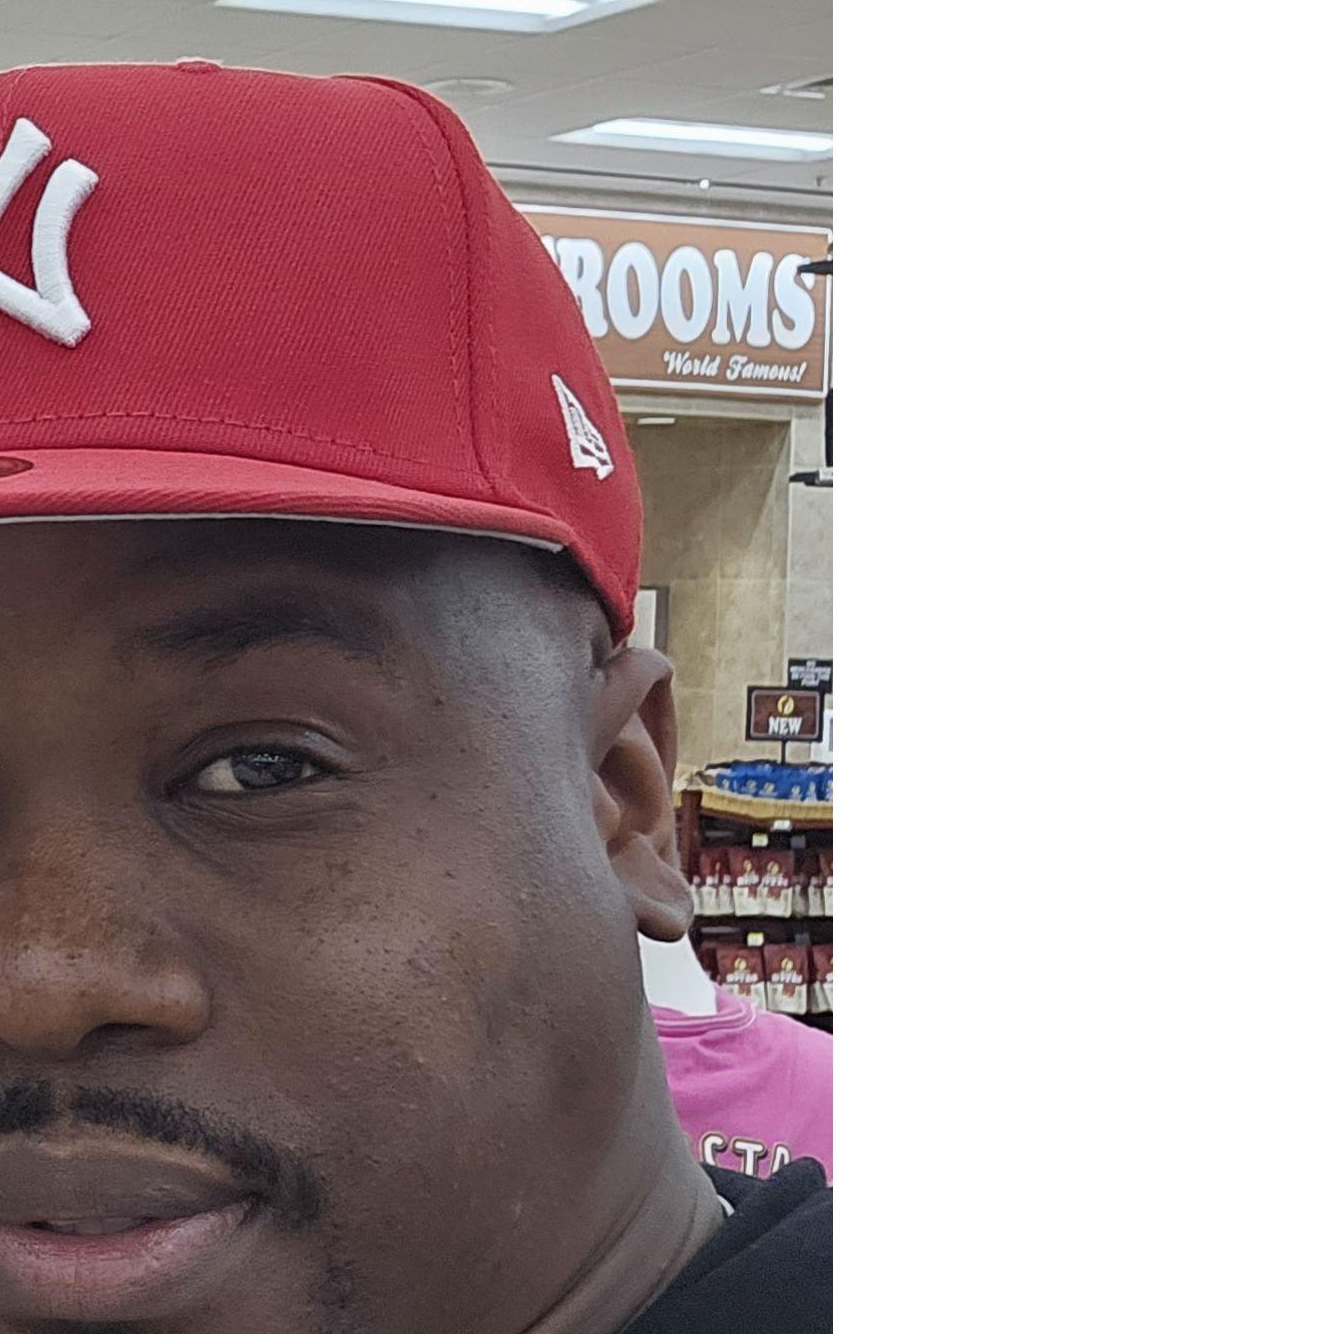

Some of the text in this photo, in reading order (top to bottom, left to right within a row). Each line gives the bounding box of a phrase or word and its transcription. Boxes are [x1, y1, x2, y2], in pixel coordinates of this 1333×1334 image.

[541, 235, 816, 351] ROOMS
[663, 349, 807, 384] World Famous!
[767, 715, 803, 736] NEW
